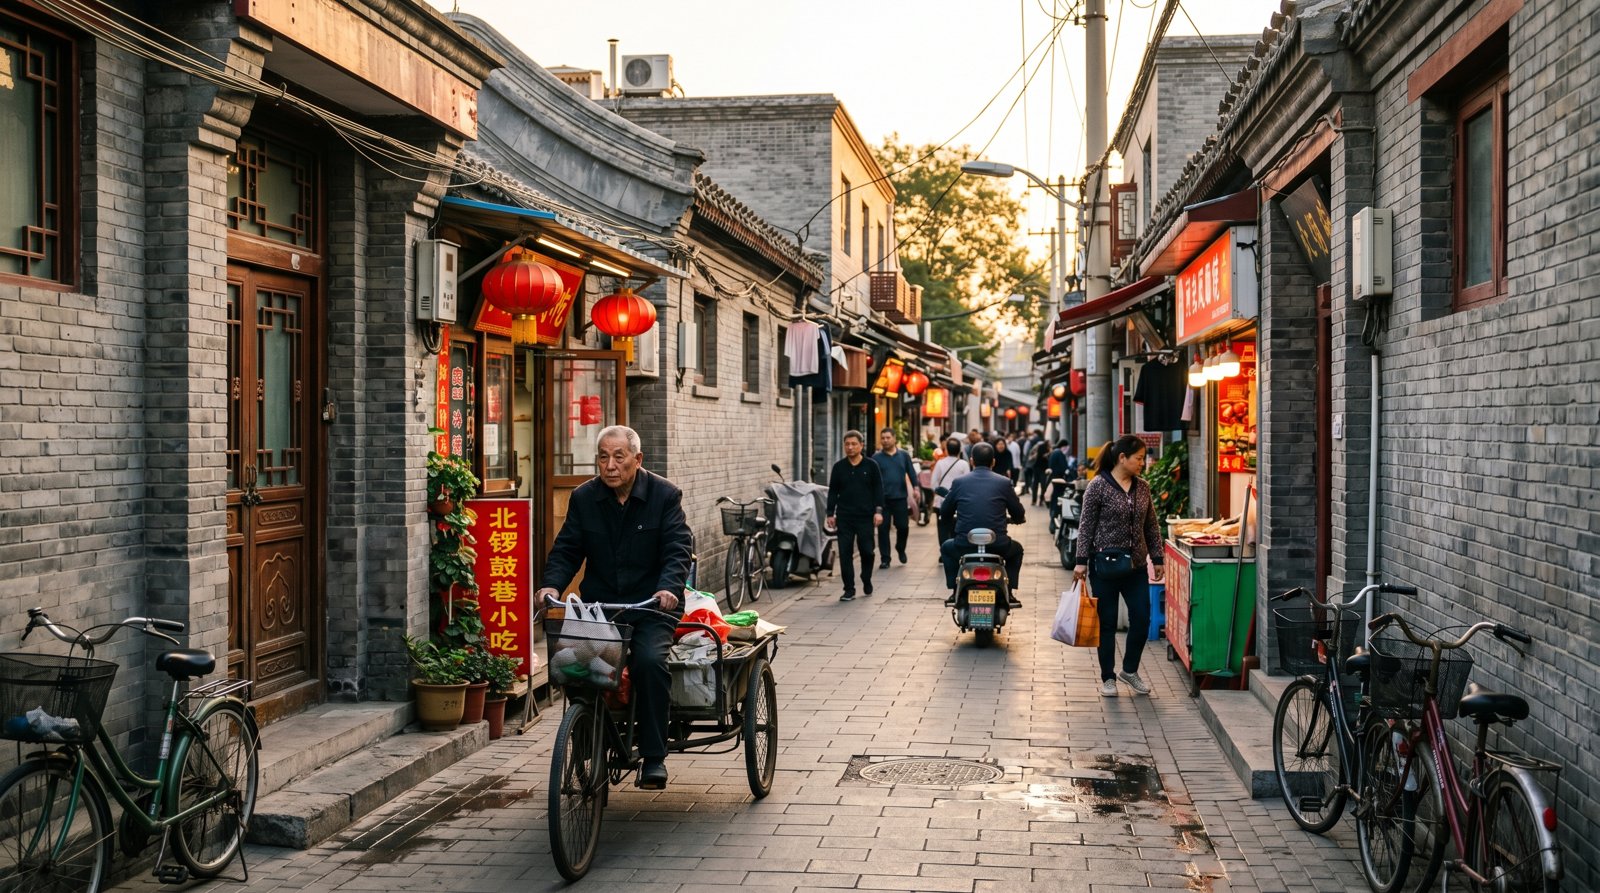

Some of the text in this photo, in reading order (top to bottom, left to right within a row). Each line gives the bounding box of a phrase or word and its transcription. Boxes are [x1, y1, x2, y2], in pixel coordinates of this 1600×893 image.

[489, 507, 519, 651] 北锣鼓巷小吃
